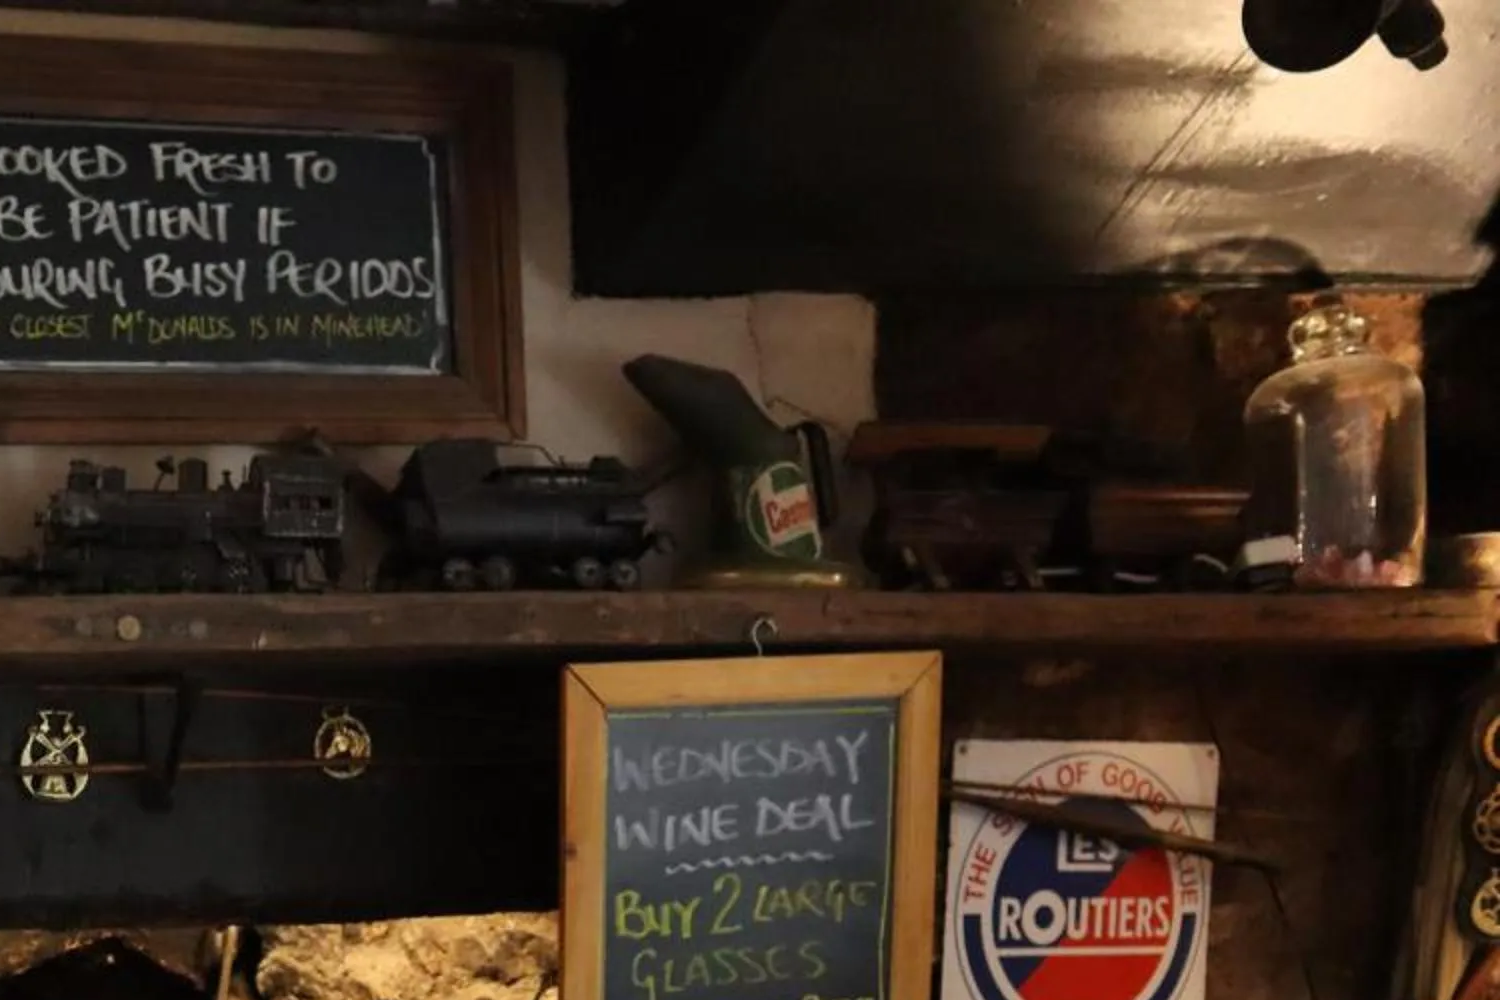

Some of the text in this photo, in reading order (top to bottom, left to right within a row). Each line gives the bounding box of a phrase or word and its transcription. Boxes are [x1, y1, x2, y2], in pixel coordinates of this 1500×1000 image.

[149, 141, 272, 197] FRESH
[286, 150, 338, 189] TO
[68, 199, 233, 251] PATIENT
[257, 205, 297, 246] IF
[144, 253, 246, 302] BUSY
[267, 249, 434, 306] PERIODS
[10, 312, 94, 340] CLOSEST
[250, 312, 270, 339] IS
[276, 314, 300, 341] IN
[613, 730, 869, 794] WEDNESDAY
[613, 793, 874, 852] WINE DEAL
[963, 843, 997, 903] THE
[1056, 761, 1090, 788] OF
[614, 872, 878, 939] BUY 2 LARGE
[999, 889, 1169, 946] ROUTIERS
